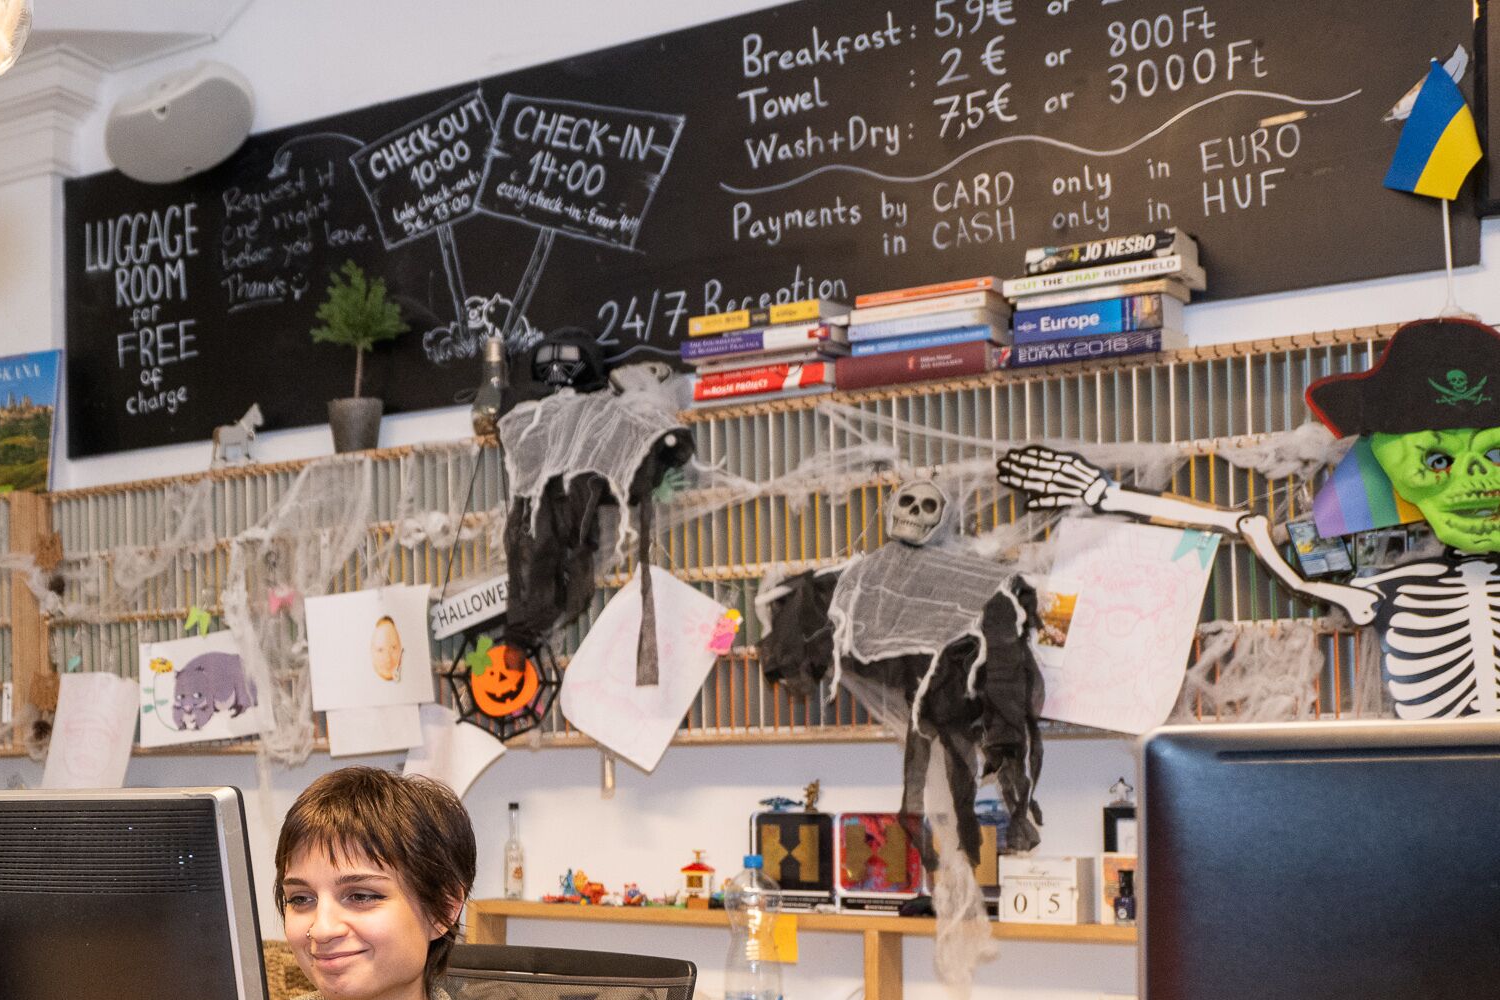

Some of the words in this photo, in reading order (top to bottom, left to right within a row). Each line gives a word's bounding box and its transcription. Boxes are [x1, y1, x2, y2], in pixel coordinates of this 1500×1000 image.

[934, 0, 1017, 38] 5,9€
[1047, 0, 1075, 16] or
[737, 76, 830, 124] Towel
[1045, 48, 1073, 68] or
[933, 82, 1019, 139] 7,5€
[1044, 92, 1075, 114] or
[369, 99, 484, 181] CHECK-OUT
[513, 105, 656, 162] CHECK-IN
[410, 140, 472, 190] 10:00
[528, 150, 606, 197] 14:00
[733, 196, 862, 245] Payments
[881, 191, 908, 228] by
[932, 171, 1015, 212] CARD
[1052, 164, 1113, 200] only
[1147, 158, 1171, 180] in
[1200, 123, 1300, 173] EURO
[883, 233, 907, 256] in
[932, 206, 1016, 250] CASH
[1052, 201, 1111, 232] only
[1148, 198, 1172, 223] in
[1203, 168, 1285, 217] HUF
[85, 202, 199, 273] LUGGAGE
[1080, 243, 1102, 262] JO
[115, 258, 188, 308] ROOM
[1013, 281, 1037, 292] CUT
[1041, 278, 1063, 288] THE
[1066, 271, 1100, 285] CRAP
[1104, 265, 1137, 278] RUTH
[1141, 259, 1176, 273] FIELD
[129, 304, 161, 329] for
[596, 288, 689, 345] 24/7
[1040, 313, 1100, 331] Europe
[116, 319, 199, 368] FREE
[1019, 349, 1073, 363] EURAIL
[1073, 337, 1129, 357] 2016
[125, 385, 189, 415] charge
[140, 367, 163, 391] of
[1047, 893, 1060, 914] 5
